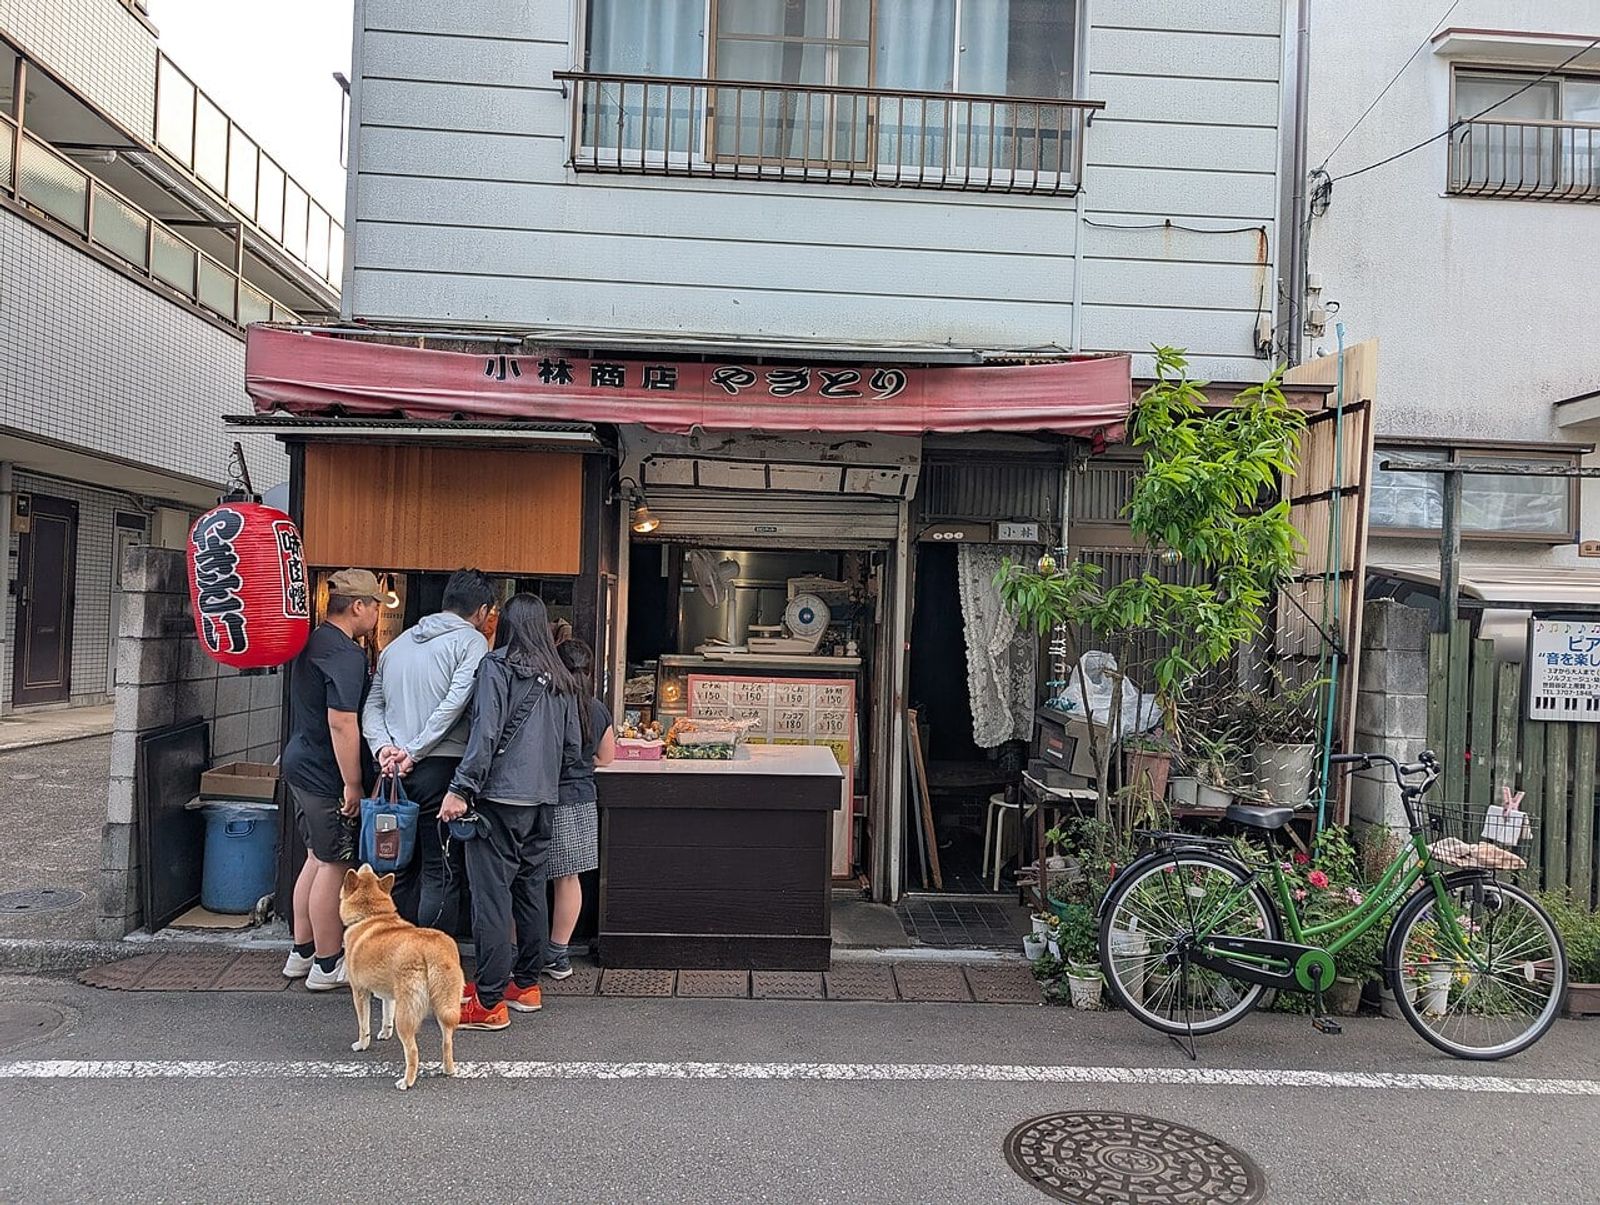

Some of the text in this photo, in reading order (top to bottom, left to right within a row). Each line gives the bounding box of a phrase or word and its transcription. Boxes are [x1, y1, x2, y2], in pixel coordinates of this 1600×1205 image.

[484, 357, 907, 400] 小林商店 やきとり
[1003, 526, 1033, 538] 小林
[192, 508, 248, 654] やきとり
